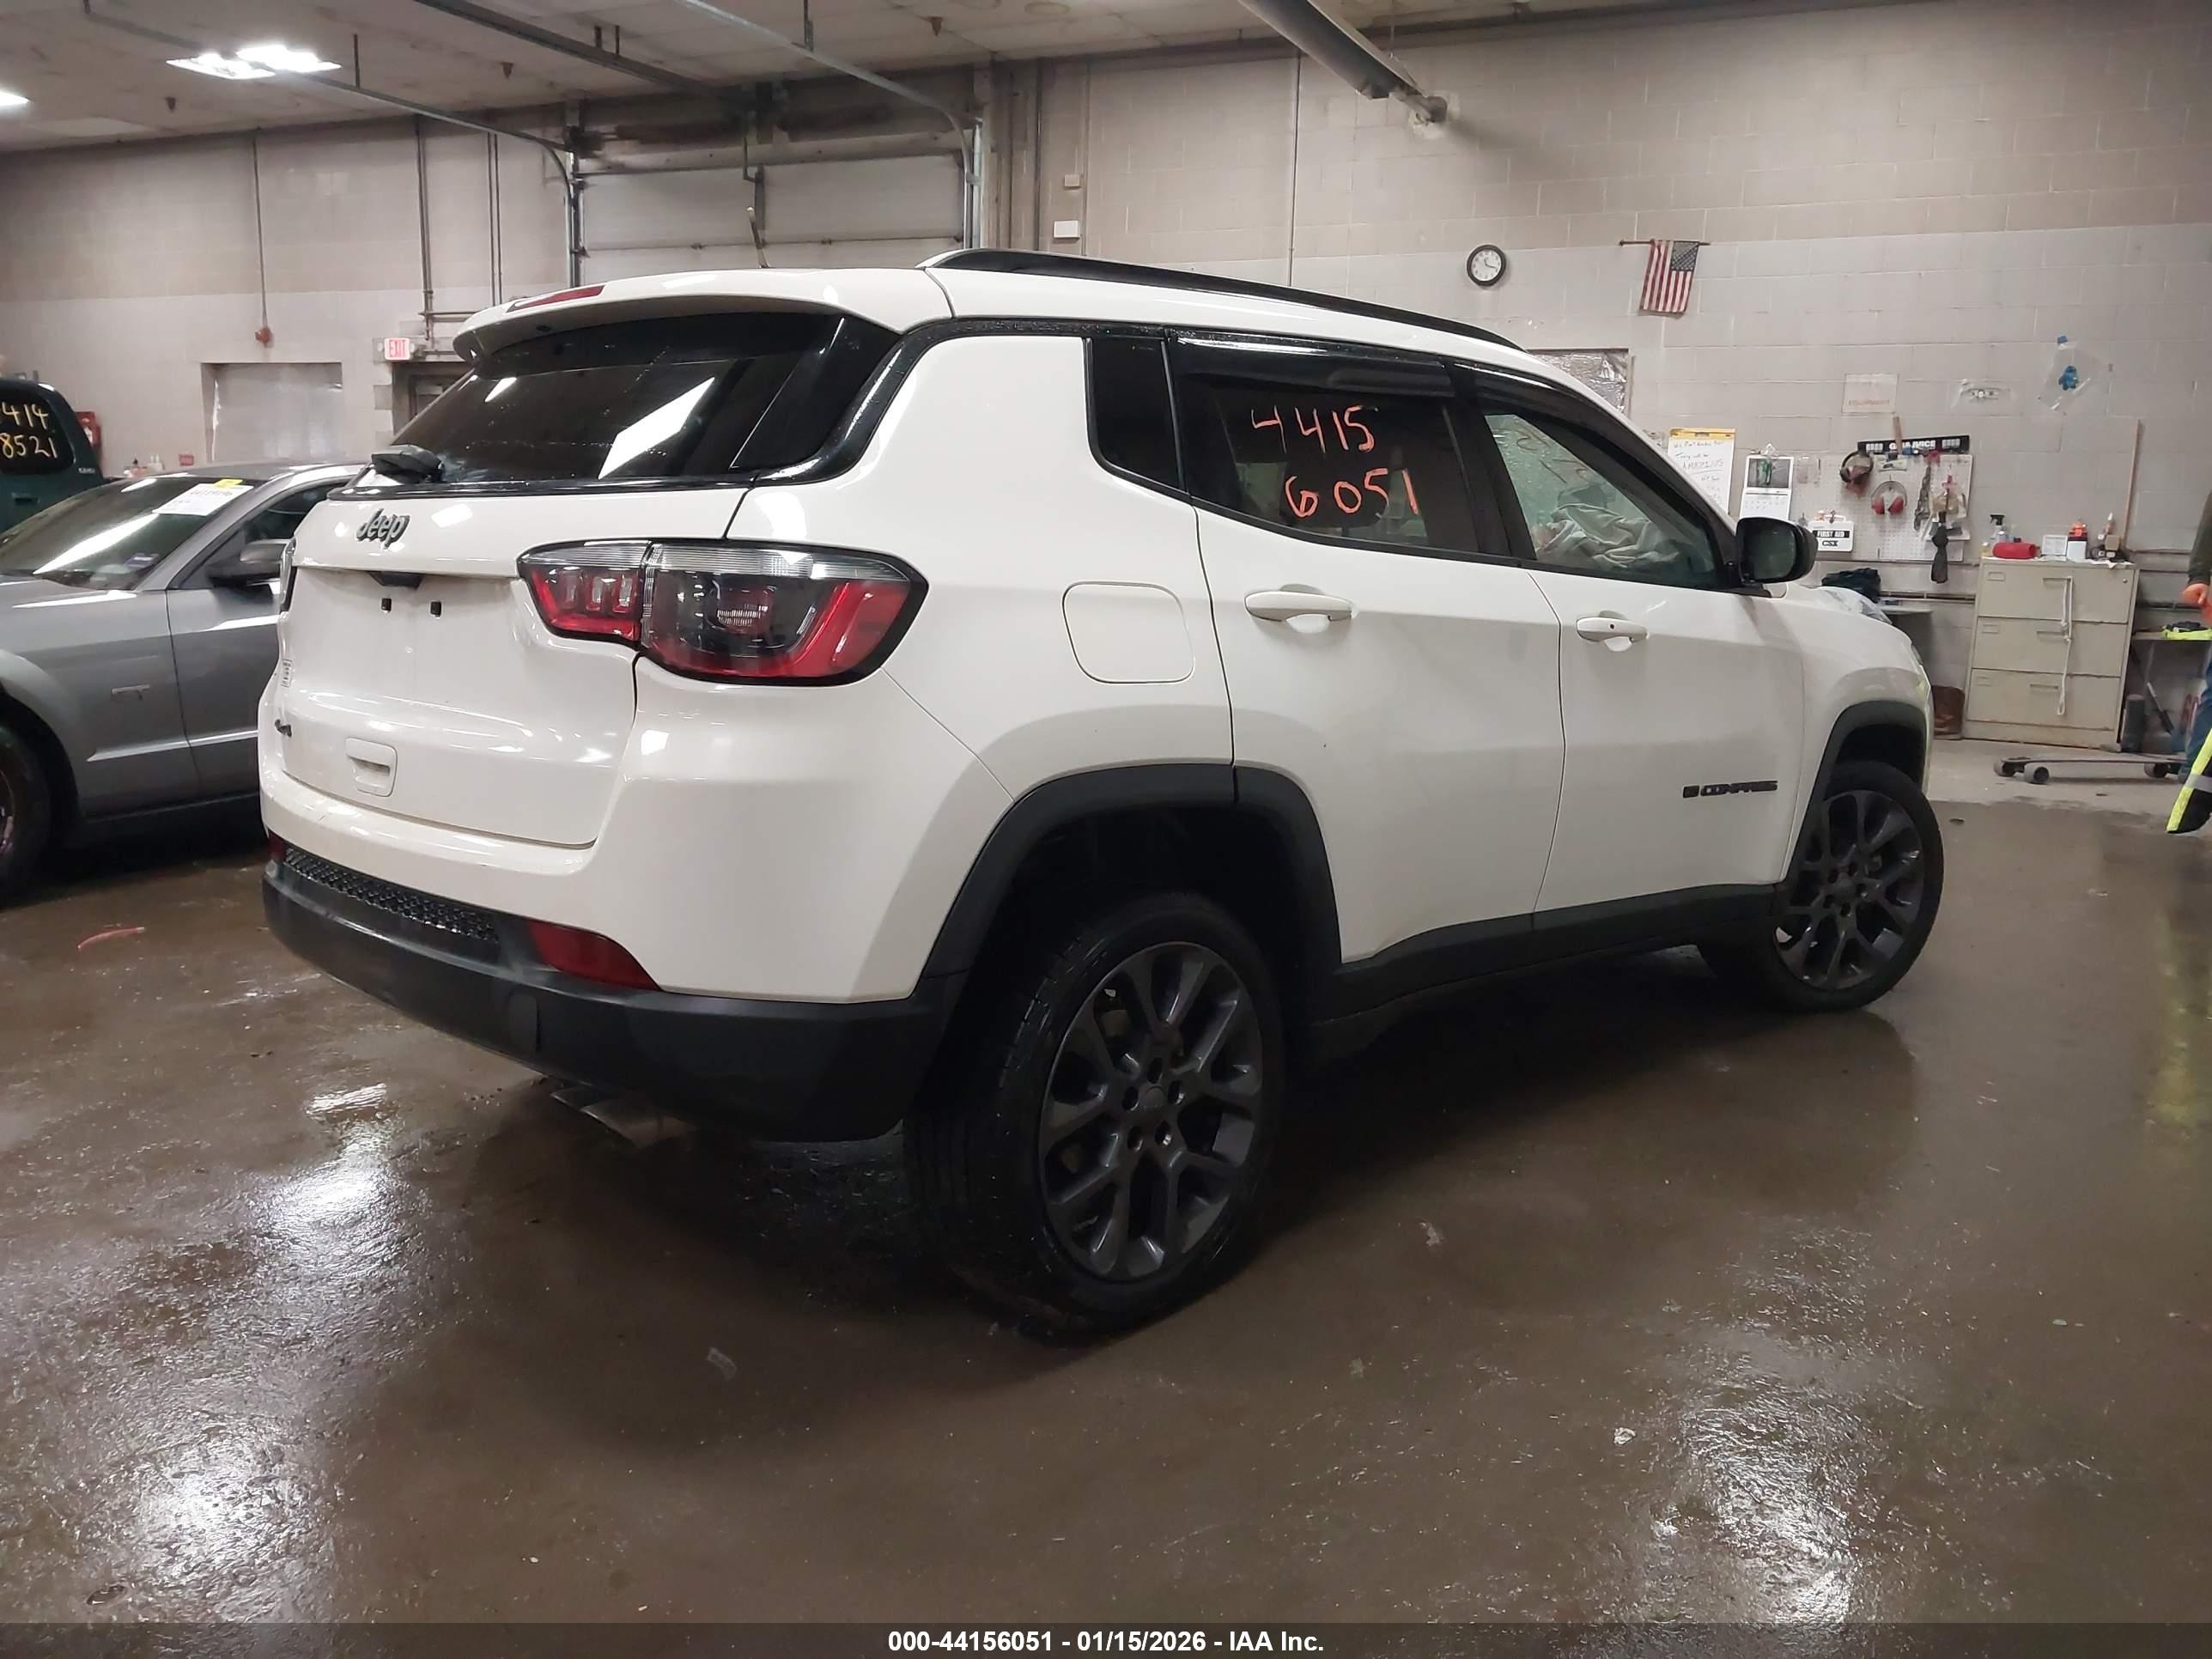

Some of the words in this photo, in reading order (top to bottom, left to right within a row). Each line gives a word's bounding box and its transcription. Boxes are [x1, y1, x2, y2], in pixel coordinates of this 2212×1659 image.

[389, 339, 406, 358] EXIT
[0, 432, 58, 459] 8521
[1250, 404, 1378, 453] 4415
[1285, 467, 1419, 518] 6051
[356, 507, 411, 548] Jeep
